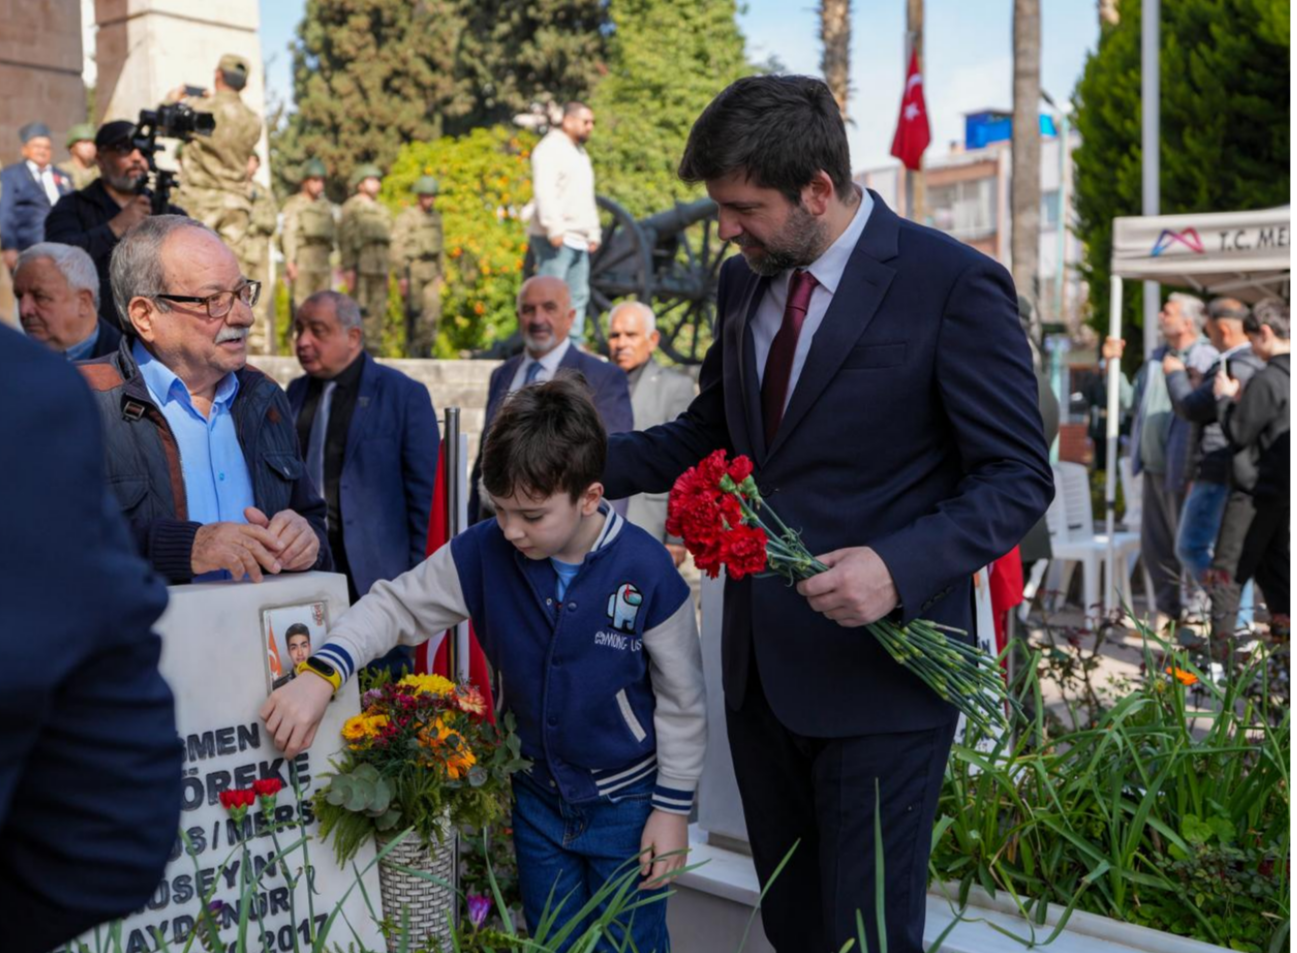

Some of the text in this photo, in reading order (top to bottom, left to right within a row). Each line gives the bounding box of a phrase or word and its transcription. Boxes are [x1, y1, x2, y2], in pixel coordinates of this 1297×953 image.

[1219, 226, 1291, 252] T.C. ME
[594, 631, 643, 652] AMONG US
[226, 789, 323, 847] MERS
